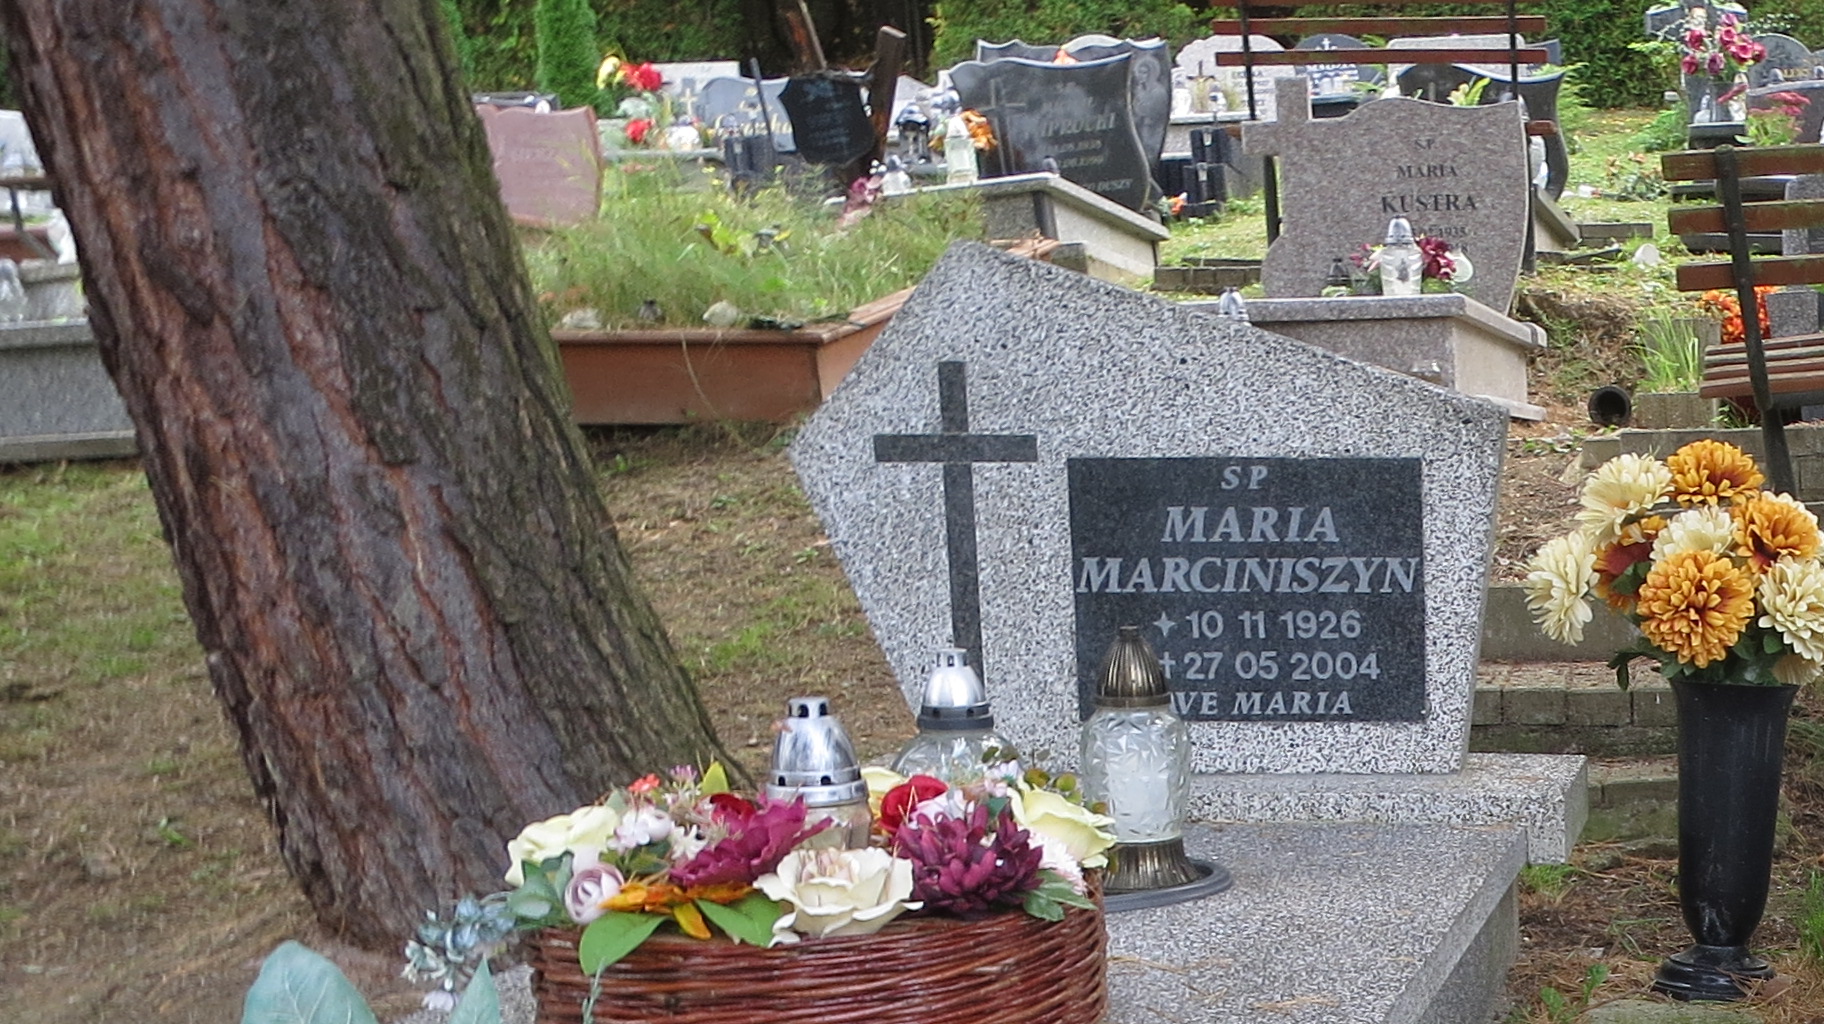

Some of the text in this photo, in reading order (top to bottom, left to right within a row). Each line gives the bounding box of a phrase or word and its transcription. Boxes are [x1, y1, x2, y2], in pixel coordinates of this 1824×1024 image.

[1396, 163, 1459, 179] MARIA
[1380, 192, 1478, 214] KUSTRA
[1160, 505, 1340, 543] MARIA
[1075, 556, 1420, 594] MARCINISZYN
[1185, 609, 1362, 639] 10 11 1926
[1183, 651, 1381, 681] 27 05 2004
[1231, 690, 1353, 715] MARIA
